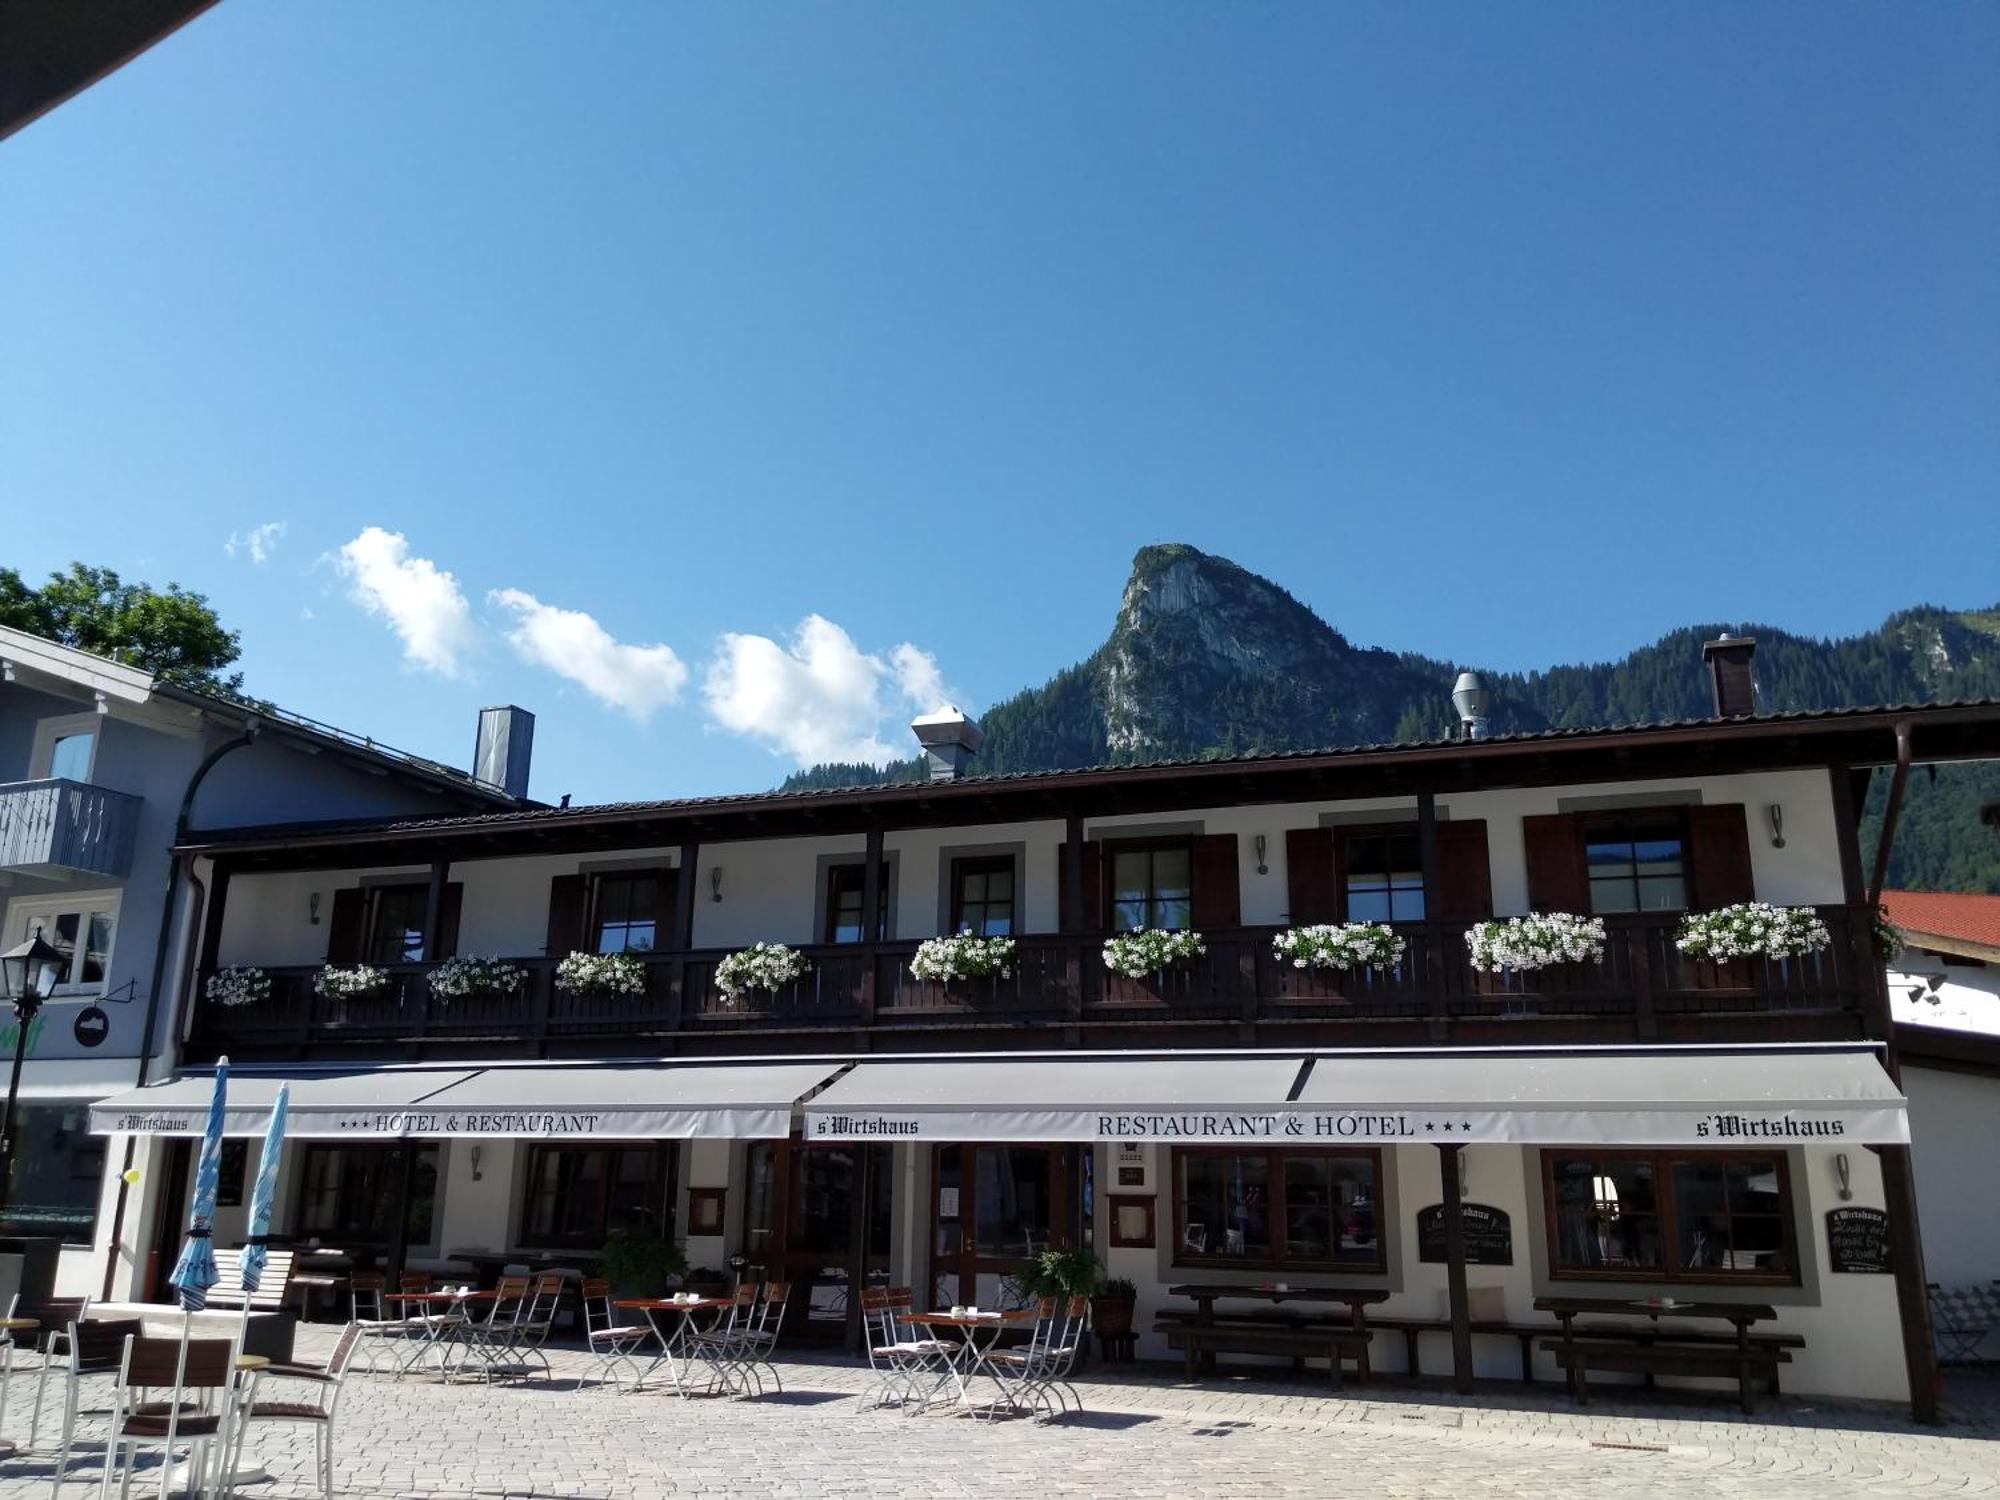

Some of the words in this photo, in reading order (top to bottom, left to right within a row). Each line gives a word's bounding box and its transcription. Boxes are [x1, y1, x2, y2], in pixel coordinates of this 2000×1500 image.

[117, 1113, 188, 1131] s'Wirtshaus
[376, 1113, 440, 1132] HOTEL
[449, 1113, 460, 1132] &
[467, 1113, 598, 1132] RESTAURANT
[817, 1114, 918, 1135] s'Wirtshaus
[1098, 1115, 1276, 1135] RESTAURANT
[1284, 1115, 1304, 1135] &
[1314, 1115, 1414, 1135] HOTEL
[1696, 1115, 1844, 1137] s'Wirtshaus
